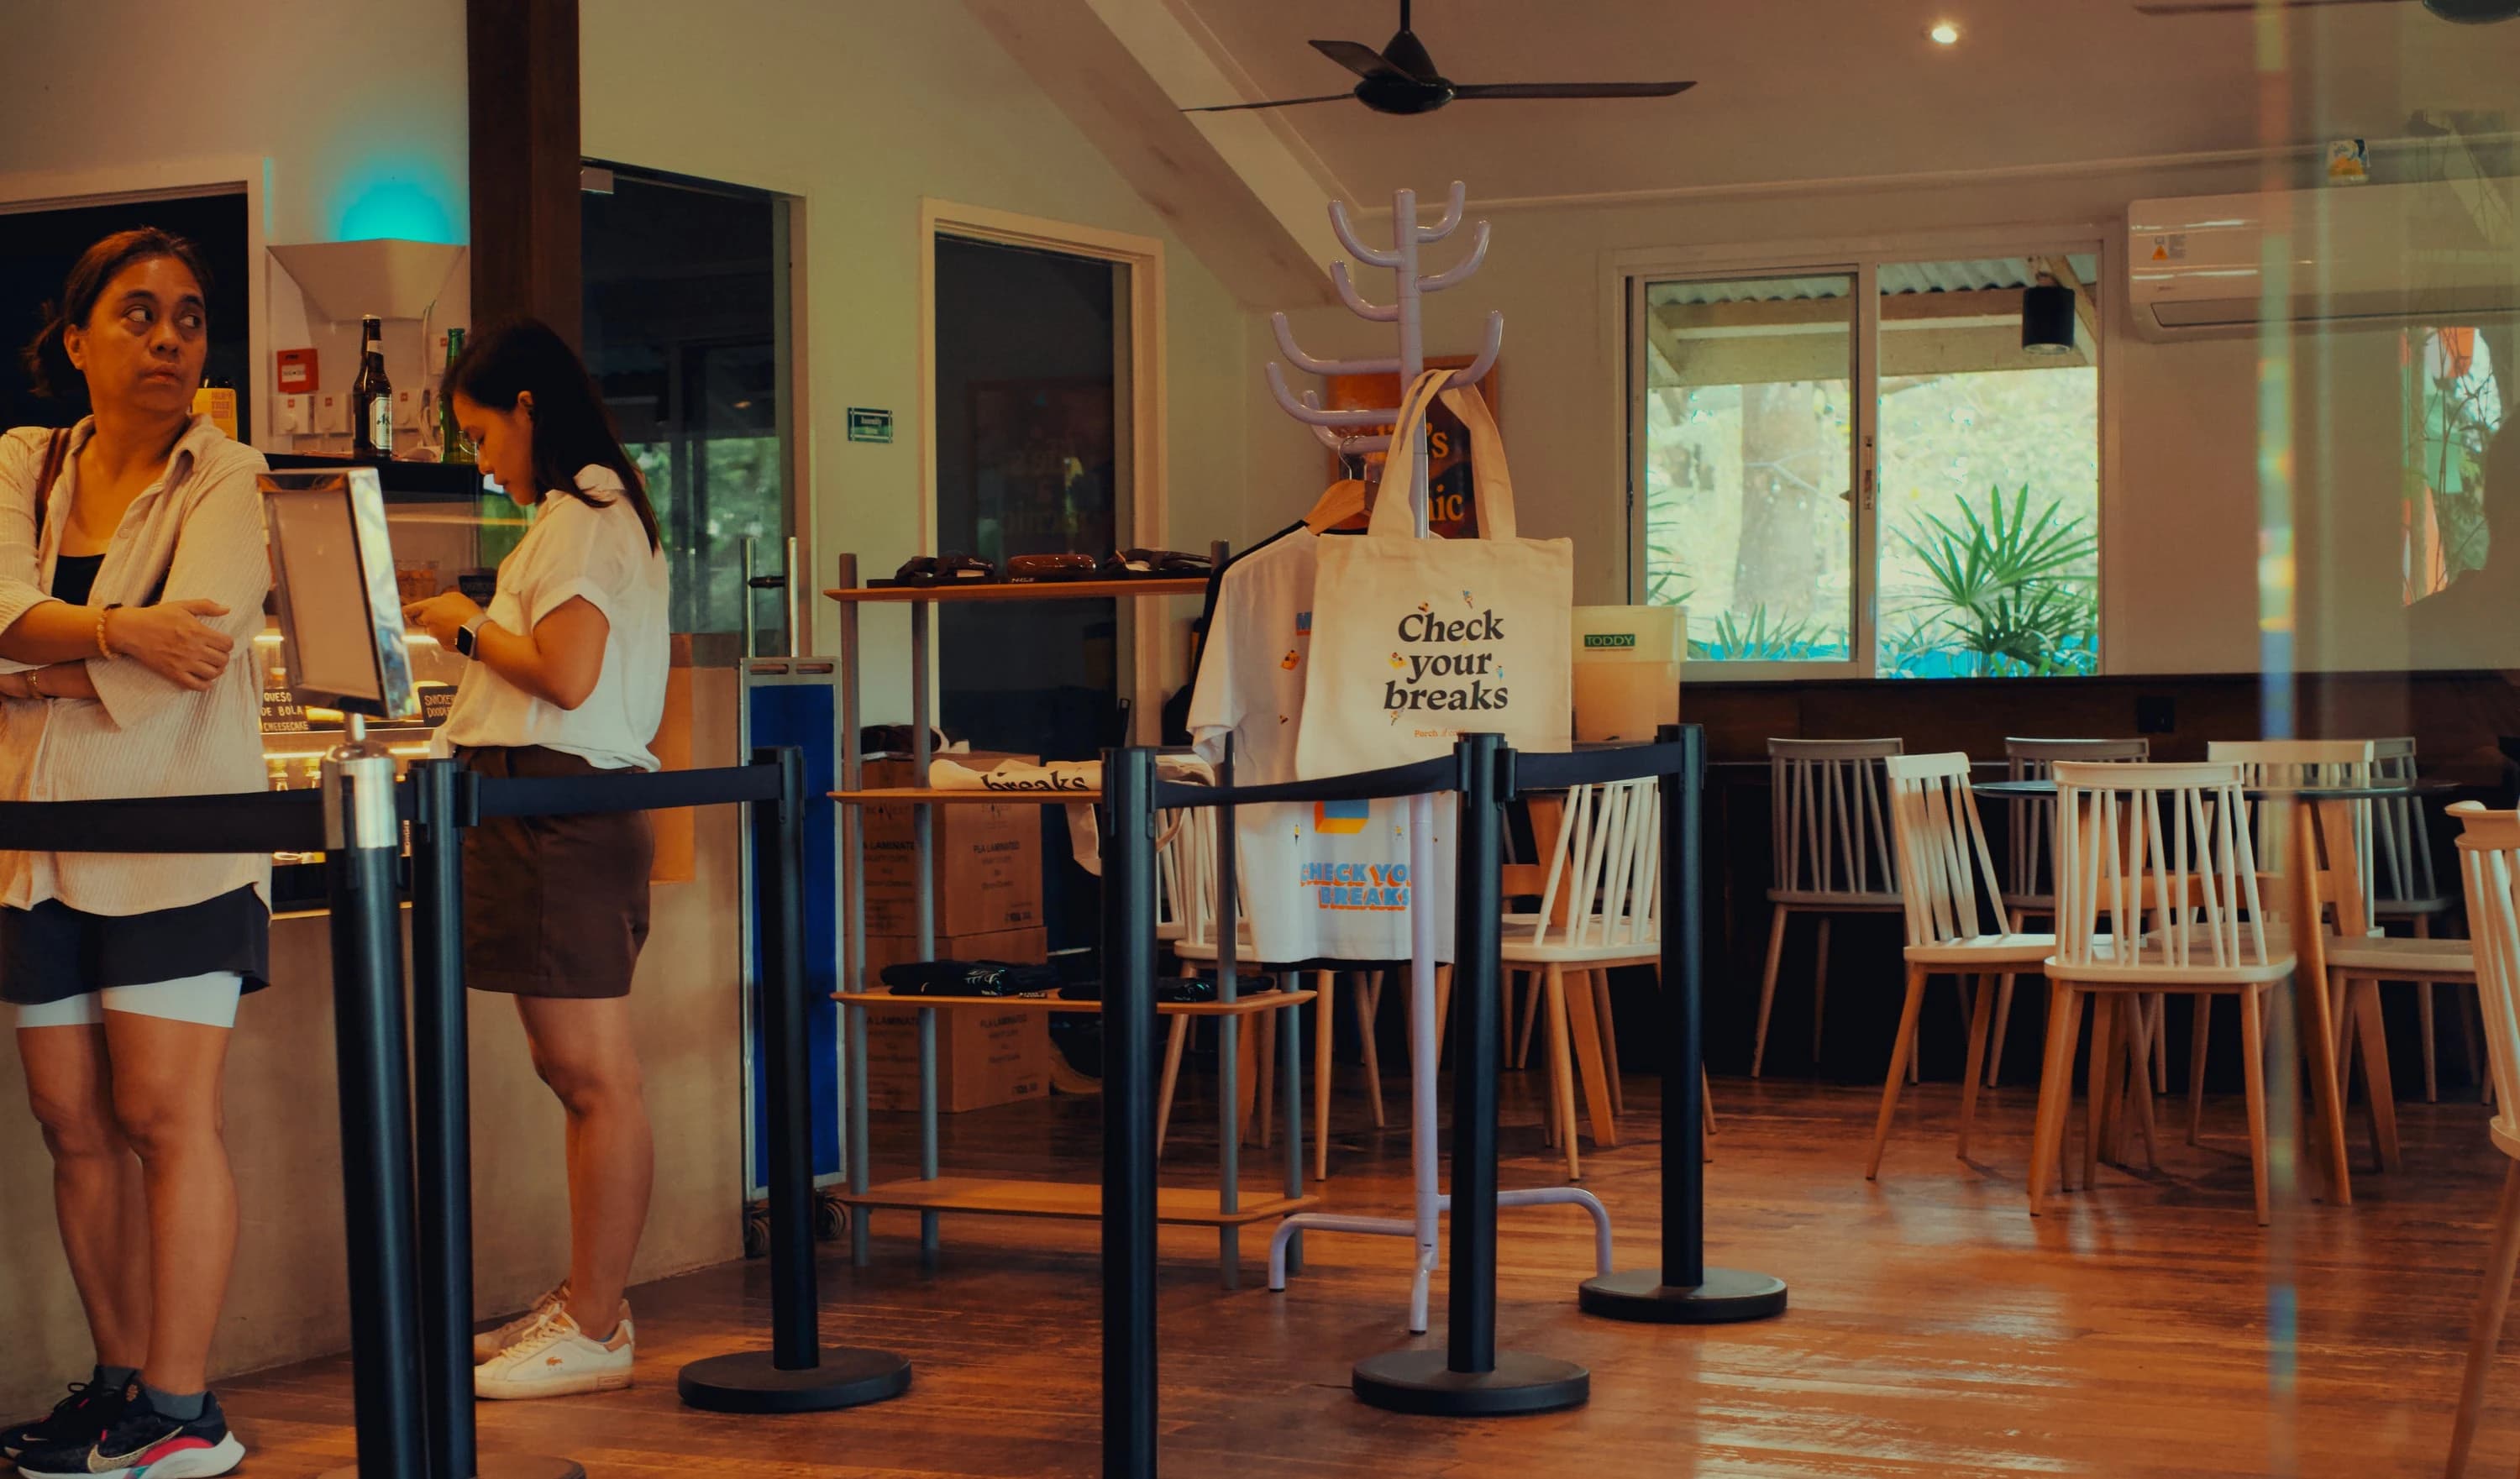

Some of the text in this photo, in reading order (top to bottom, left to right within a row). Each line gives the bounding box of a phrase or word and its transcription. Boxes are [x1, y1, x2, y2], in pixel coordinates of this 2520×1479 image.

[1398, 609, 1505, 642] Check
[1586, 635, 1634, 646] TODDY
[1406, 653, 1492, 684] your
[263, 691, 292, 703] QUESO
[1383, 679, 1508, 711] breaks
[261, 705, 303, 716] DE BOLA
[870, 841, 915, 851] LAMINATE
[1300, 862, 1410, 887] CHECK YO
